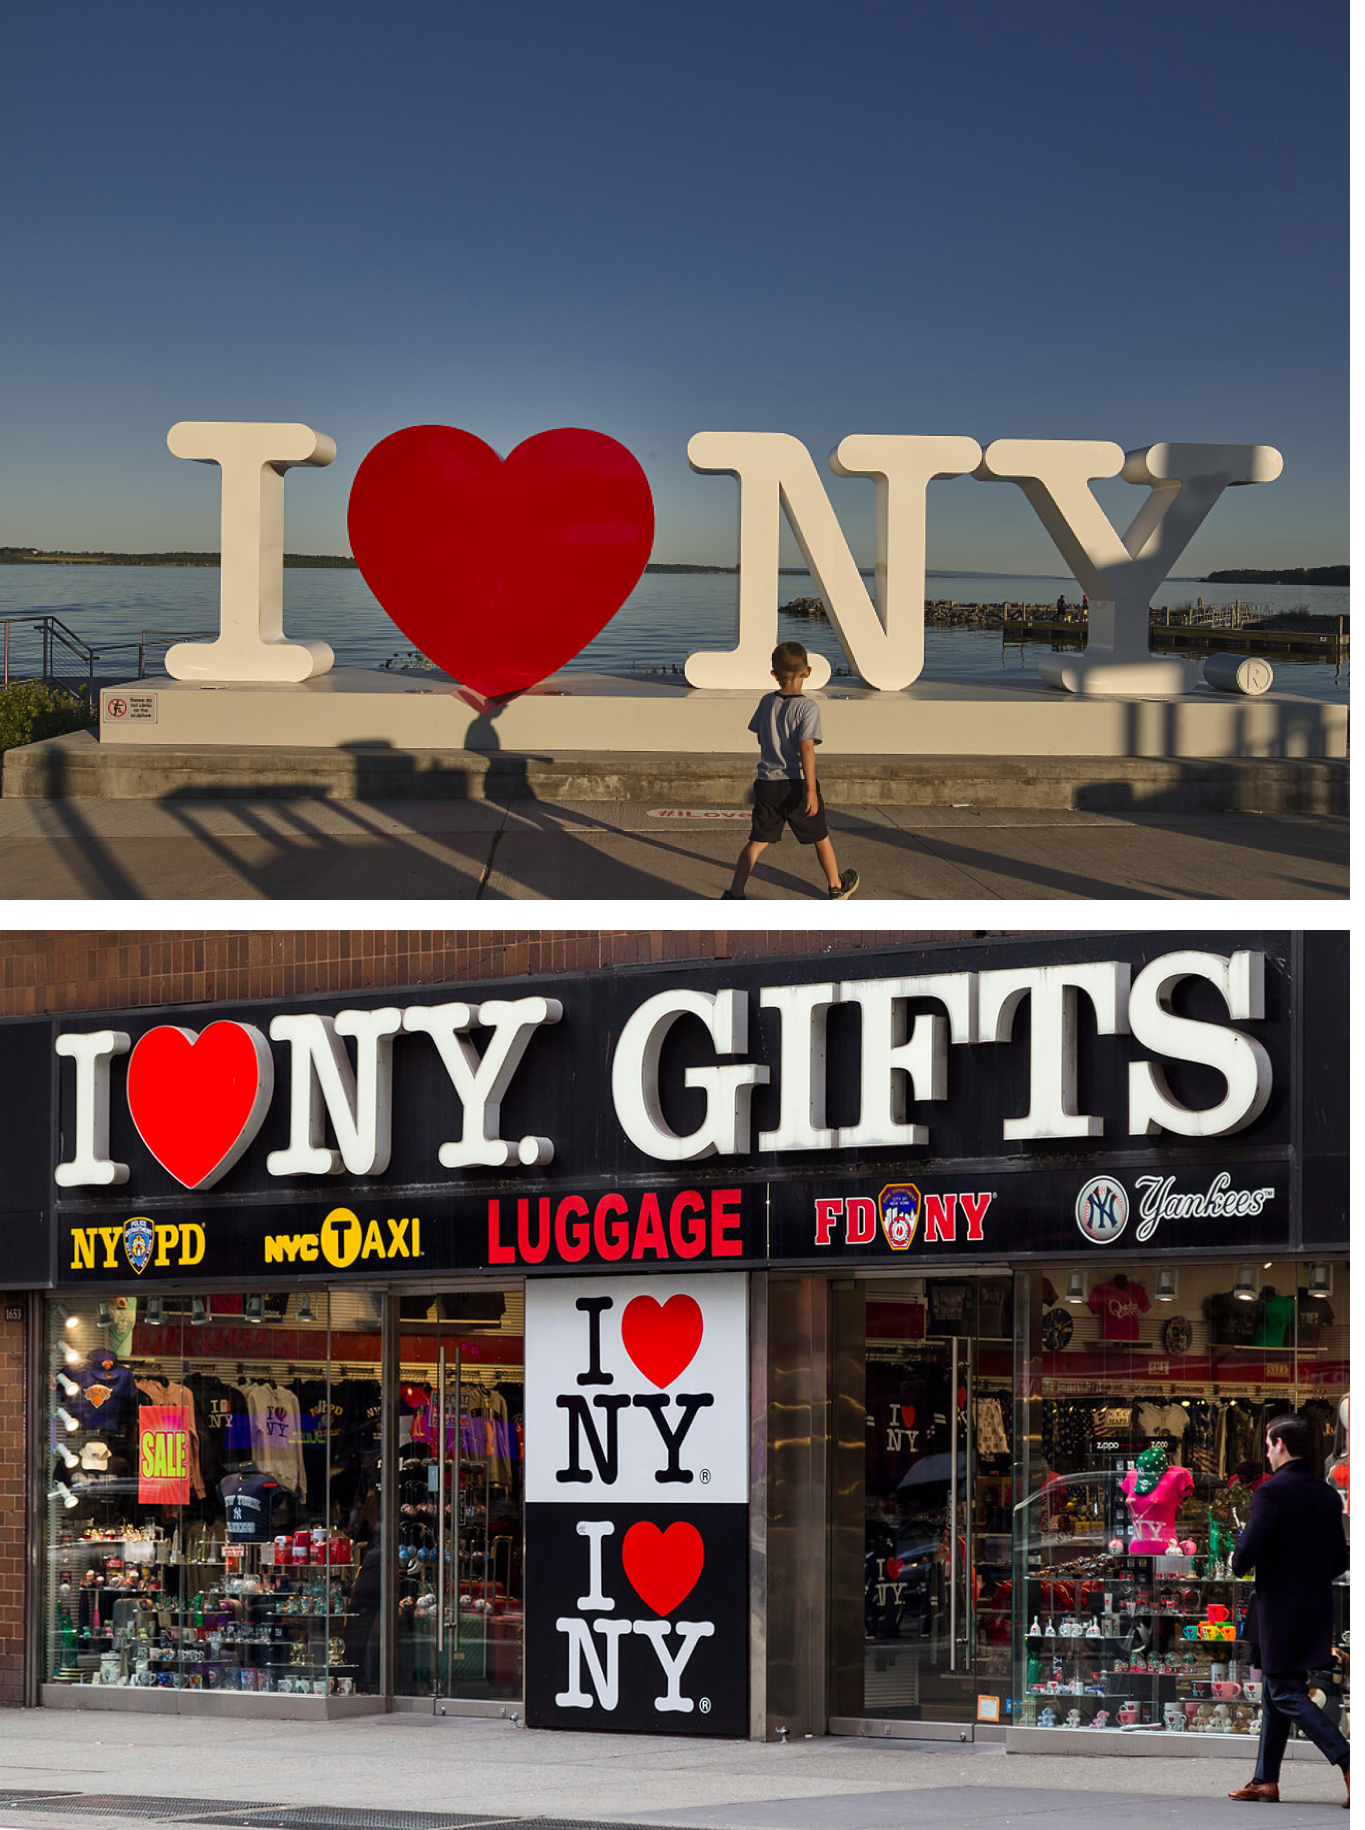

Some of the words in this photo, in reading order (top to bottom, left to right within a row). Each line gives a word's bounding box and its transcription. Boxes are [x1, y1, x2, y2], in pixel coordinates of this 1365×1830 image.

[165, 421, 337, 682] I
[684, 431, 1283, 695] NY
[55, 1030, 131, 1187] I
[612, 950, 1274, 1162] GIFTS
[264, 1233, 319, 1263] NYC
[488, 1188, 743, 1264] LUGGAGE
[1135, 1172, 1265, 1242] Yankees
[5, 1308, 22, 1320] 1653
[575, 1296, 614, 1386] I
[142, 1431, 187, 1478] SALE
[556, 1393, 715, 1485] NY
[886, 1428, 919, 1452] NY
[575, 1520, 615, 1611] I
[555, 1617, 715, 1713] NY
